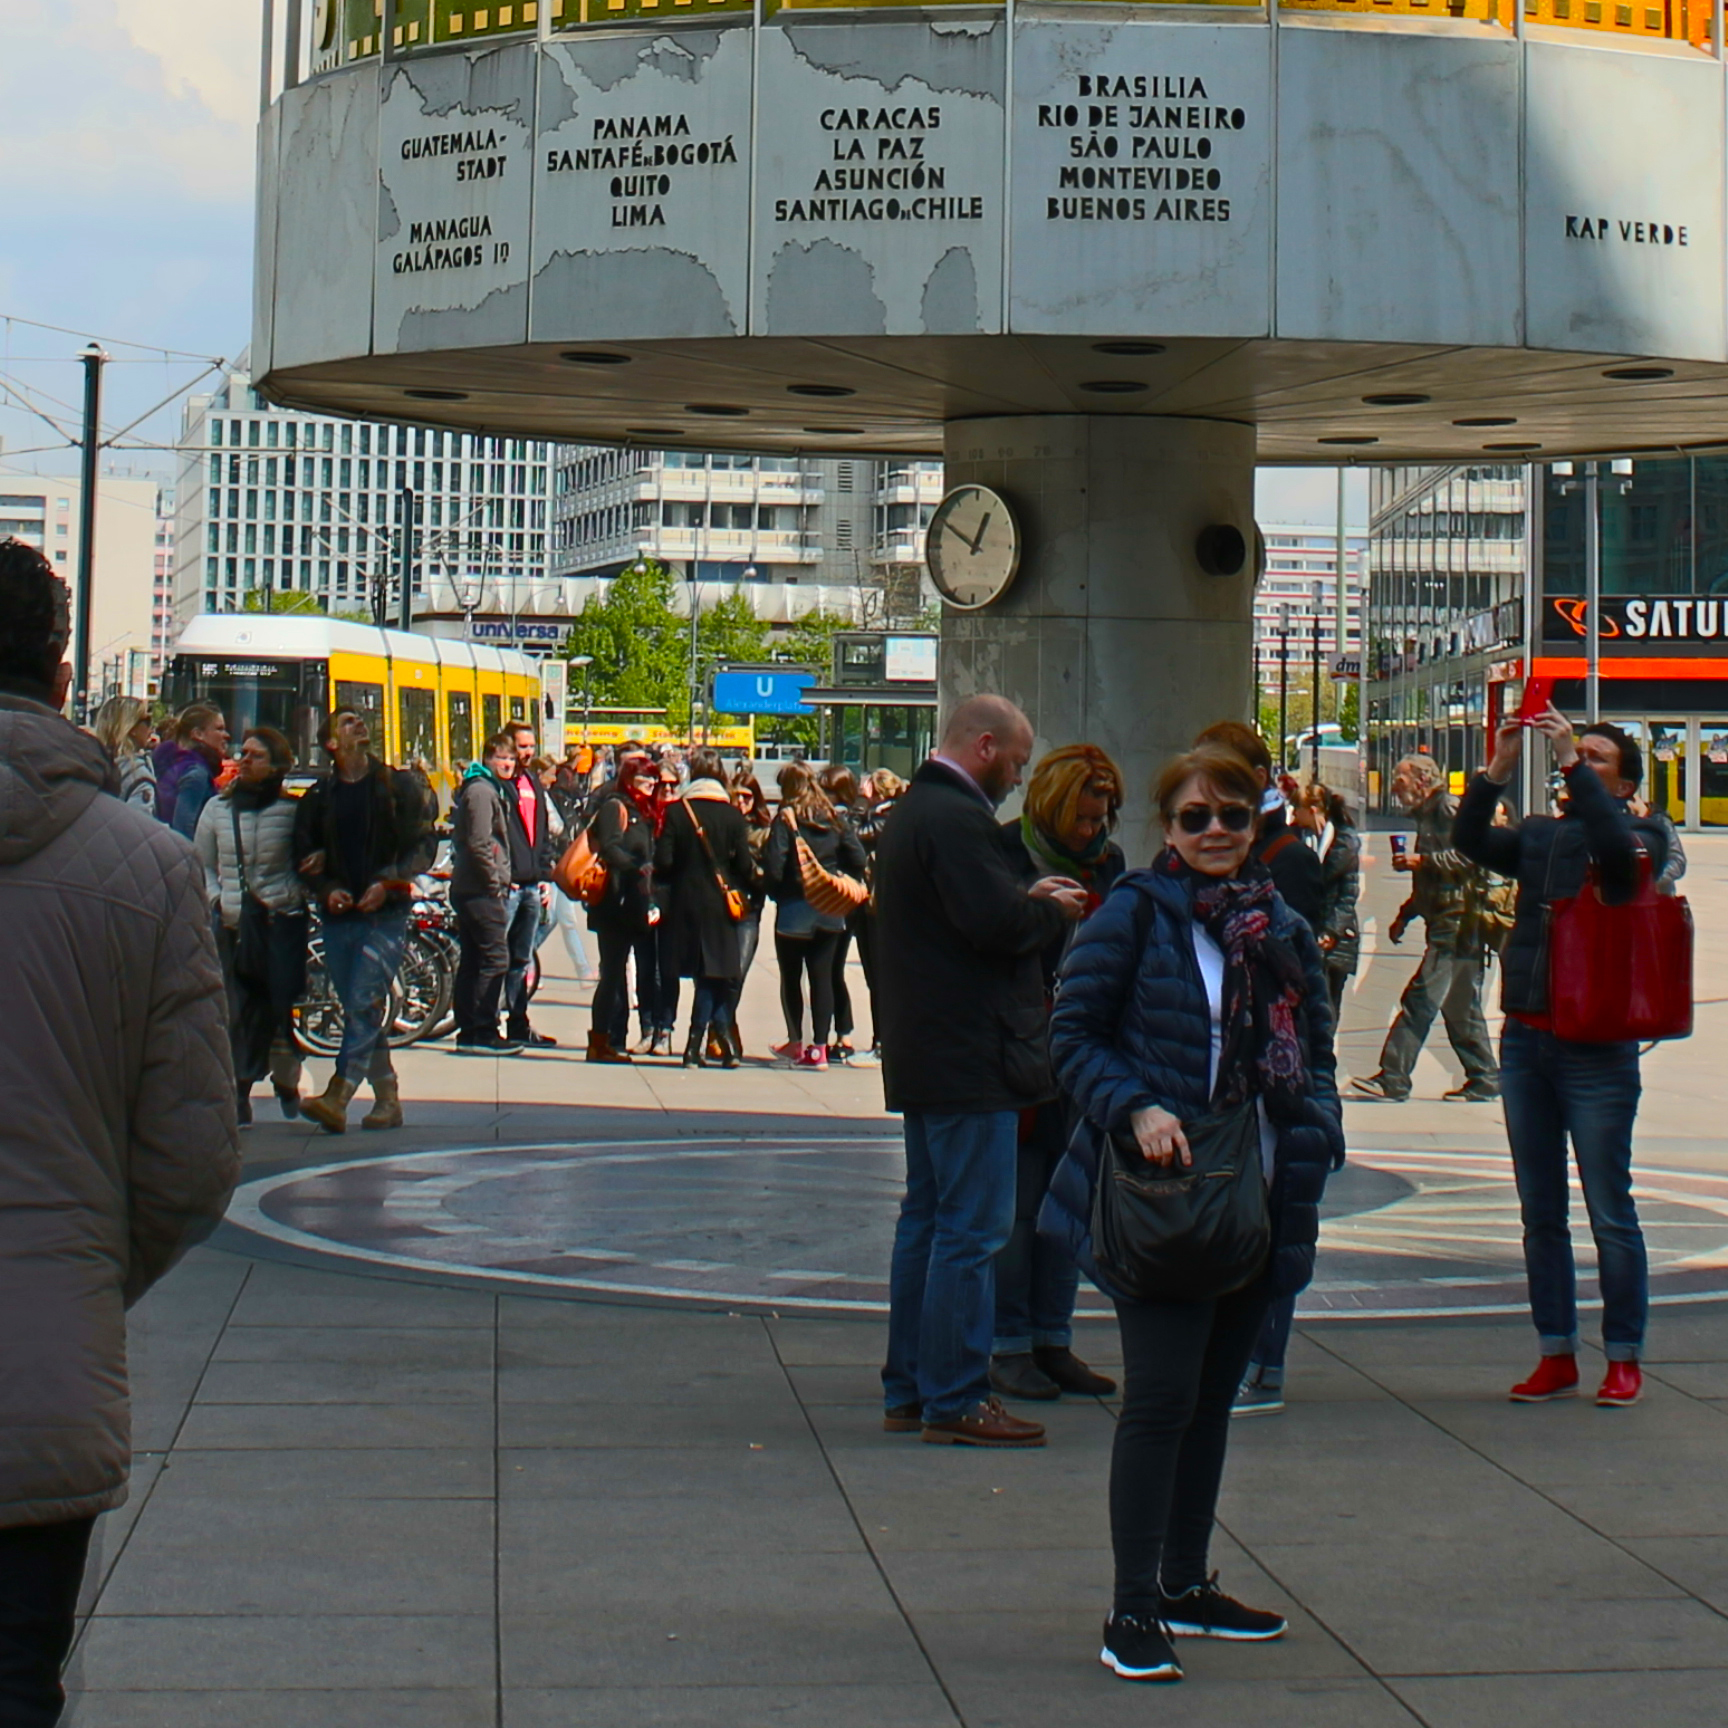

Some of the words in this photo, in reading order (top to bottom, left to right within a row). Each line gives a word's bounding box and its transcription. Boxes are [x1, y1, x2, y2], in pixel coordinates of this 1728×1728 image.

[1078, 75, 1208, 99] BRASILIA
[594, 114, 690, 140] PANAMA
[820, 107, 940, 130] CARACAS
[1038, 105, 1079, 127] RIO
[1088, 105, 1118, 127] DE
[1129, 105, 1245, 130] JANEIRO
[401, 128, 507, 160] GUATEMALA-
[834, 139, 865, 160] LA
[878, 137, 924, 160] PAZ
[1070, 130, 1118, 158] SÃO
[1132, 136, 1211, 159] PAULO
[457, 155, 507, 181] STADT
[813, 161, 945, 191] ASUNCIÓN
[1059, 166, 1221, 191] MONTEVIDEO
[610, 174, 670, 197] QUITO
[612, 204, 666, 227] LIMA
[1047, 197, 1145, 220] BUENOS
[1154, 198, 1230, 222] AIRES
[410, 215, 492, 244] MANAGUA
[1564, 214, 1609, 241] KAP
[1620, 220, 1689, 247] VERDE
[393, 243, 483, 274] GALÁPAGOS
[1335, 657, 1361, 672] dm
[756, 675, 774, 697] U
